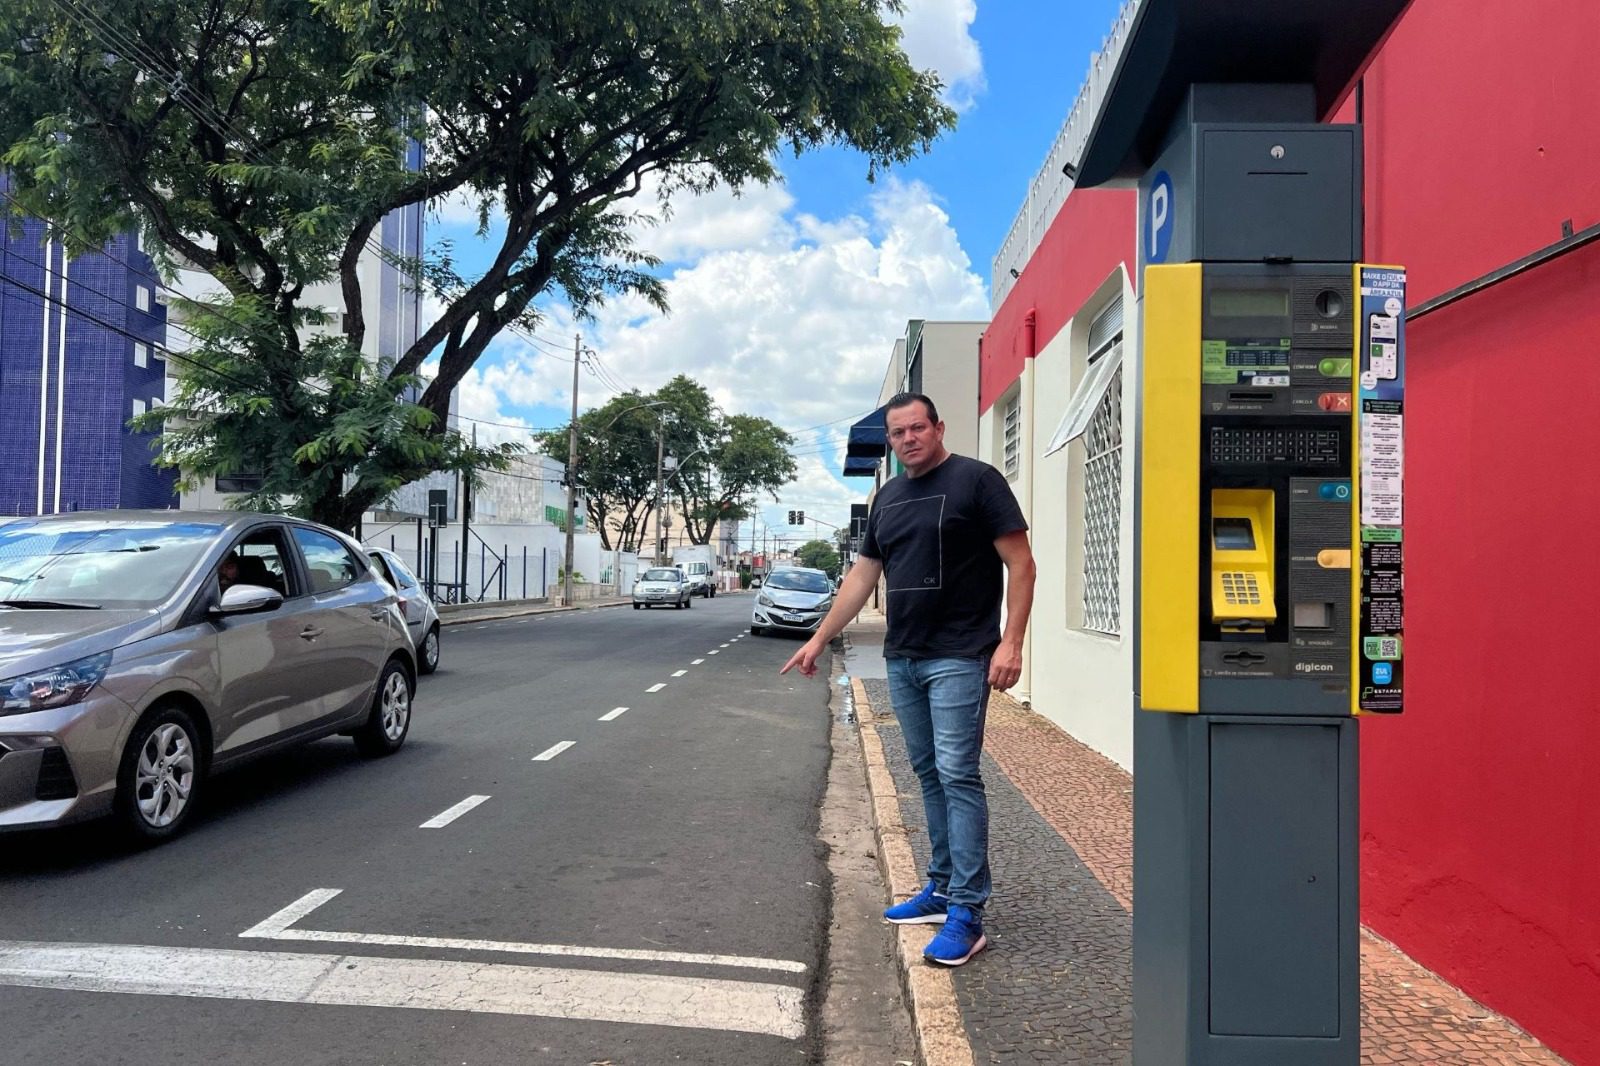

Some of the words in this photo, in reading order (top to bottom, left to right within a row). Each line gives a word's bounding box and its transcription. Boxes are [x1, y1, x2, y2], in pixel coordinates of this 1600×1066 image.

[1151, 182, 1168, 258] P
[923, 577, 936, 585] CK
[1295, 662, 1334, 673] digicon
